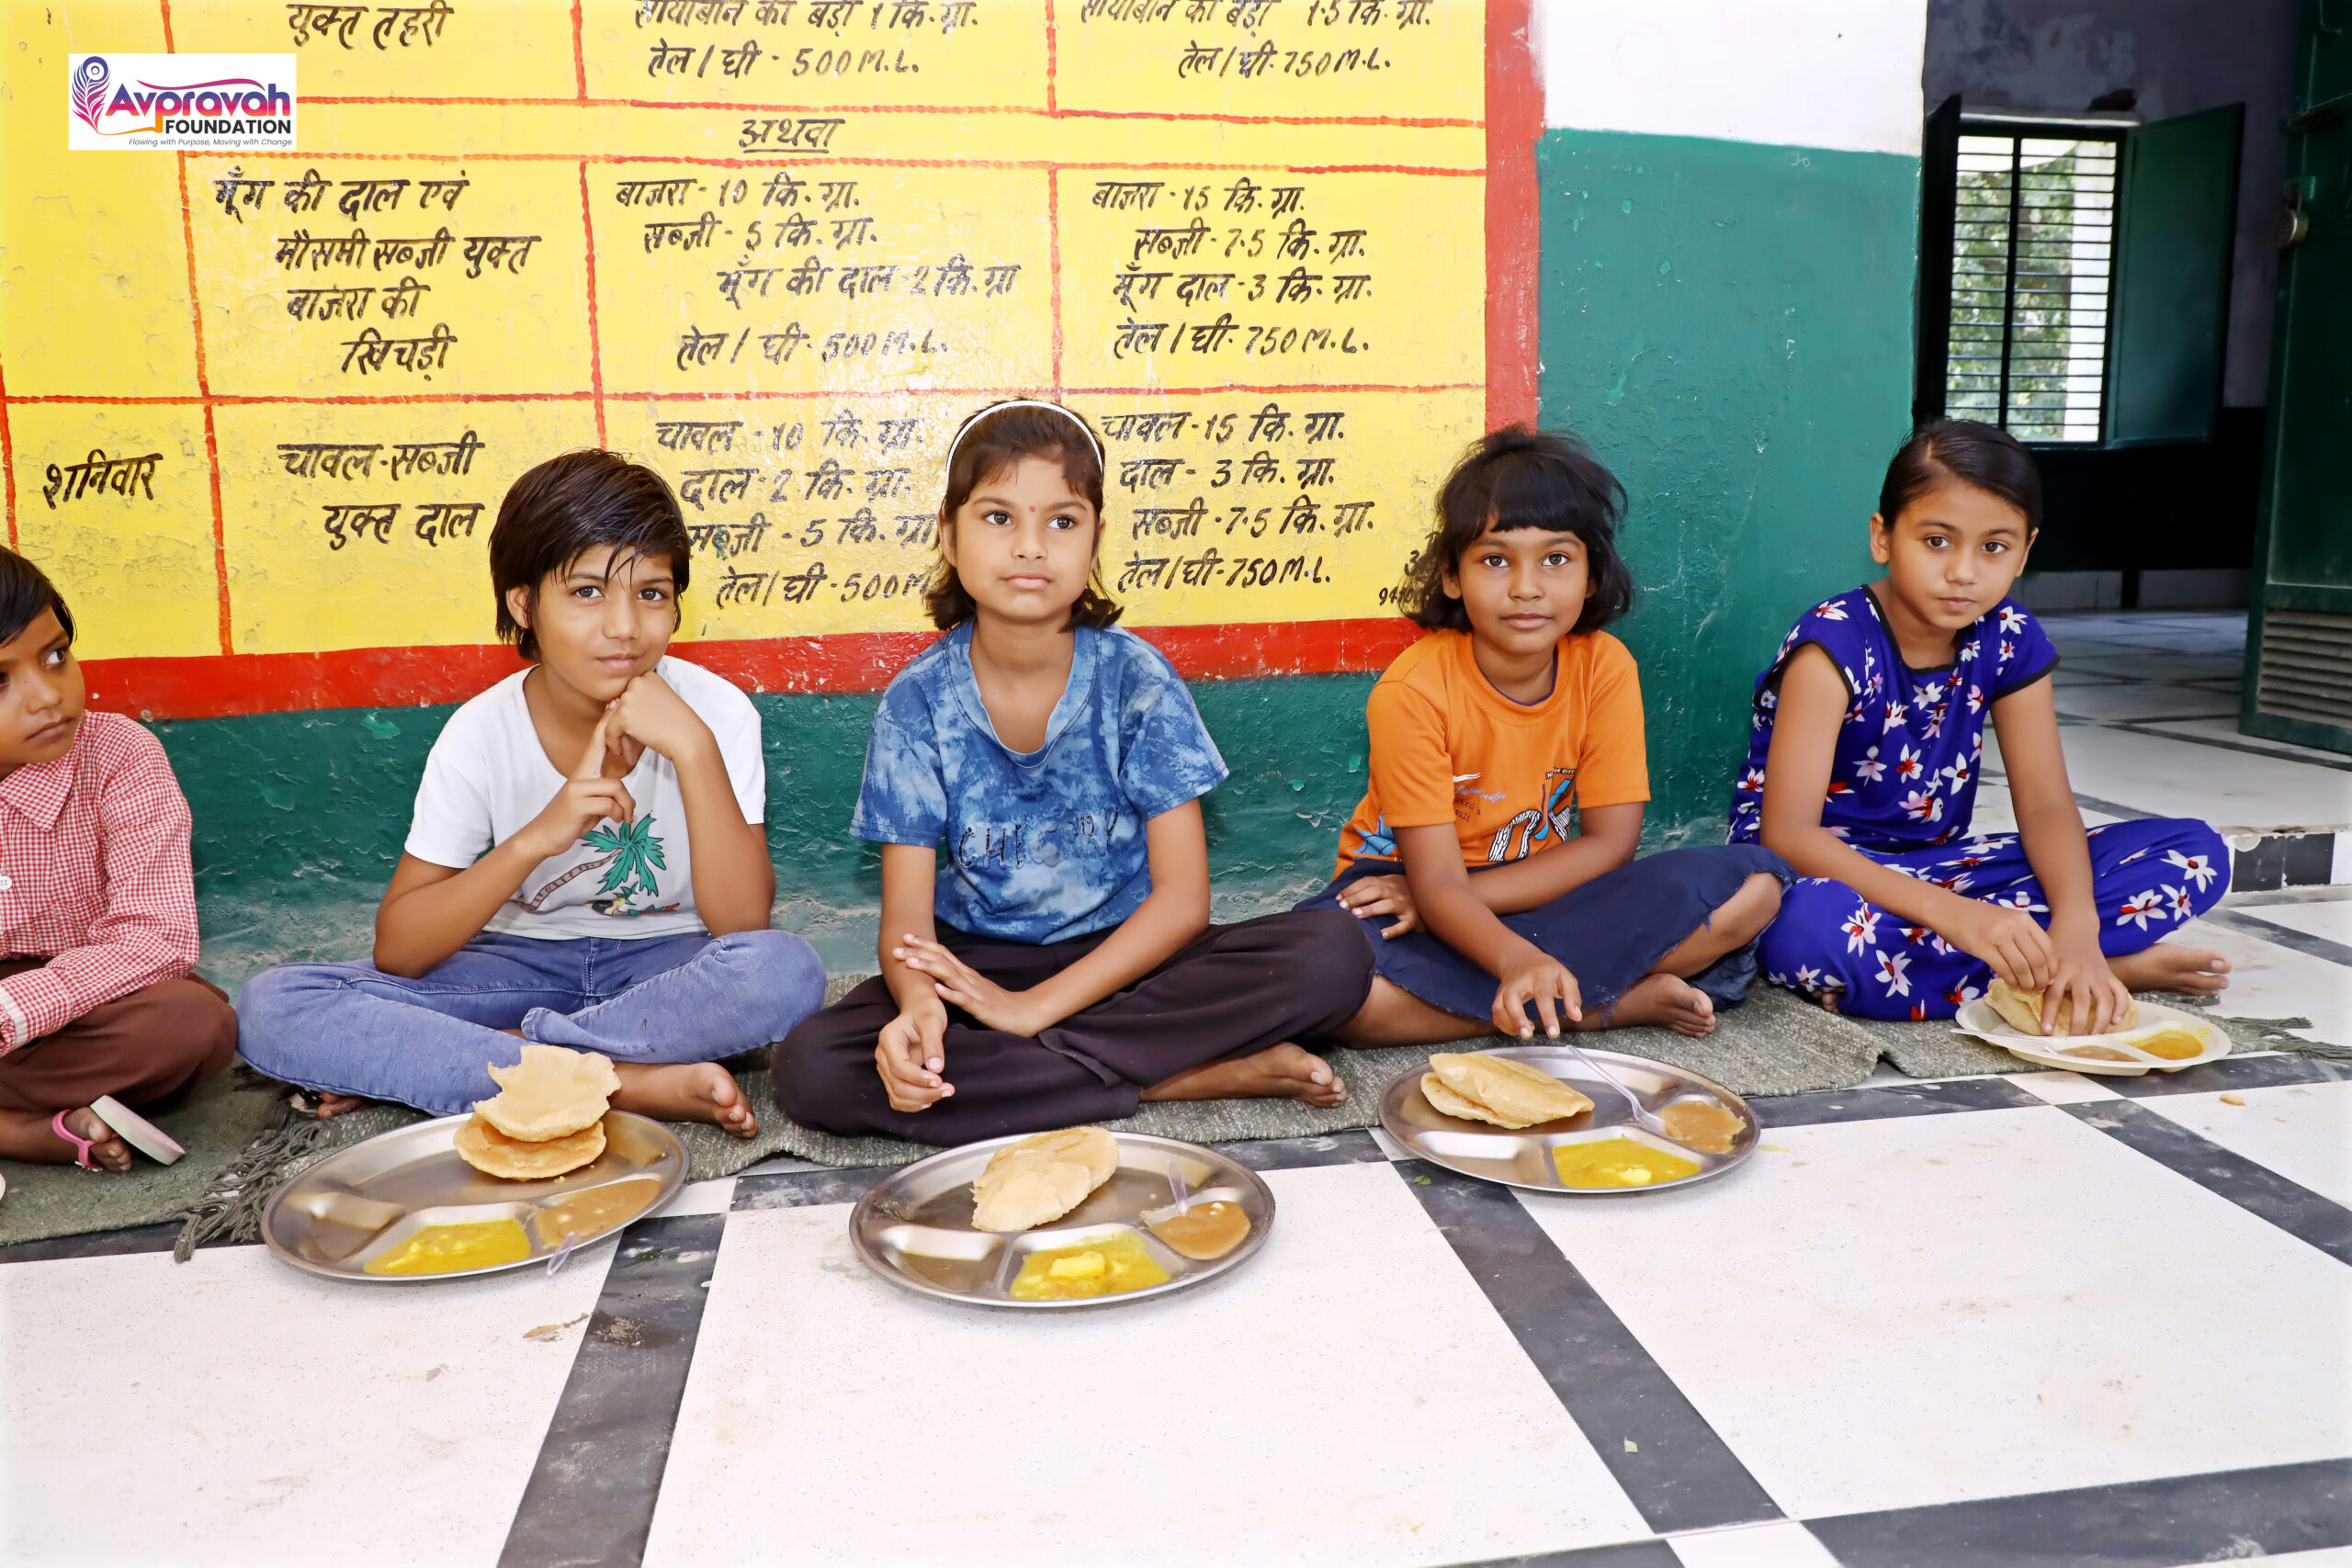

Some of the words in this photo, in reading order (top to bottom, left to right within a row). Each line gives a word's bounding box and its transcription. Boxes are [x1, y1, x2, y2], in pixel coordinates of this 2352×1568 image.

[286, 4, 369, 51] युक्त
[372, 0, 455, 51] तहरी
[648, 38, 696, 78] तेल
[1178, 39, 1225, 79] तेल
[739, 118, 846, 148] अथवा
[284, 168, 334, 214] की
[338, 179, 412, 222] दाल
[418, 169, 470, 211] एवं
[616, 178, 698, 208] बाजरा
[1091, 181, 1165, 211] बाजरा
[275, 228, 371, 272] मौसमी
[463, 235, 542, 279] युक्त
[381, 276, 432, 319] की
[786, 255, 834, 295] की
[838, 265, 899, 300] दाल
[1176, 273, 1236, 308] दाल
[676, 325, 729, 372] तेल
[1114, 317, 1170, 360] तेल
[655, 421, 744, 453] चावल
[1101, 412, 1193, 443] चावल
[42, 448, 164, 511] शनिवार
[680, 468, 760, 512] दाल
[1119, 458, 1186, 494] दाल
[322, 502, 401, 551] युक्त
[414, 502, 486, 547] दाल
[716, 565, 770, 610] तेल
[1117, 550, 1172, 593] तेल
